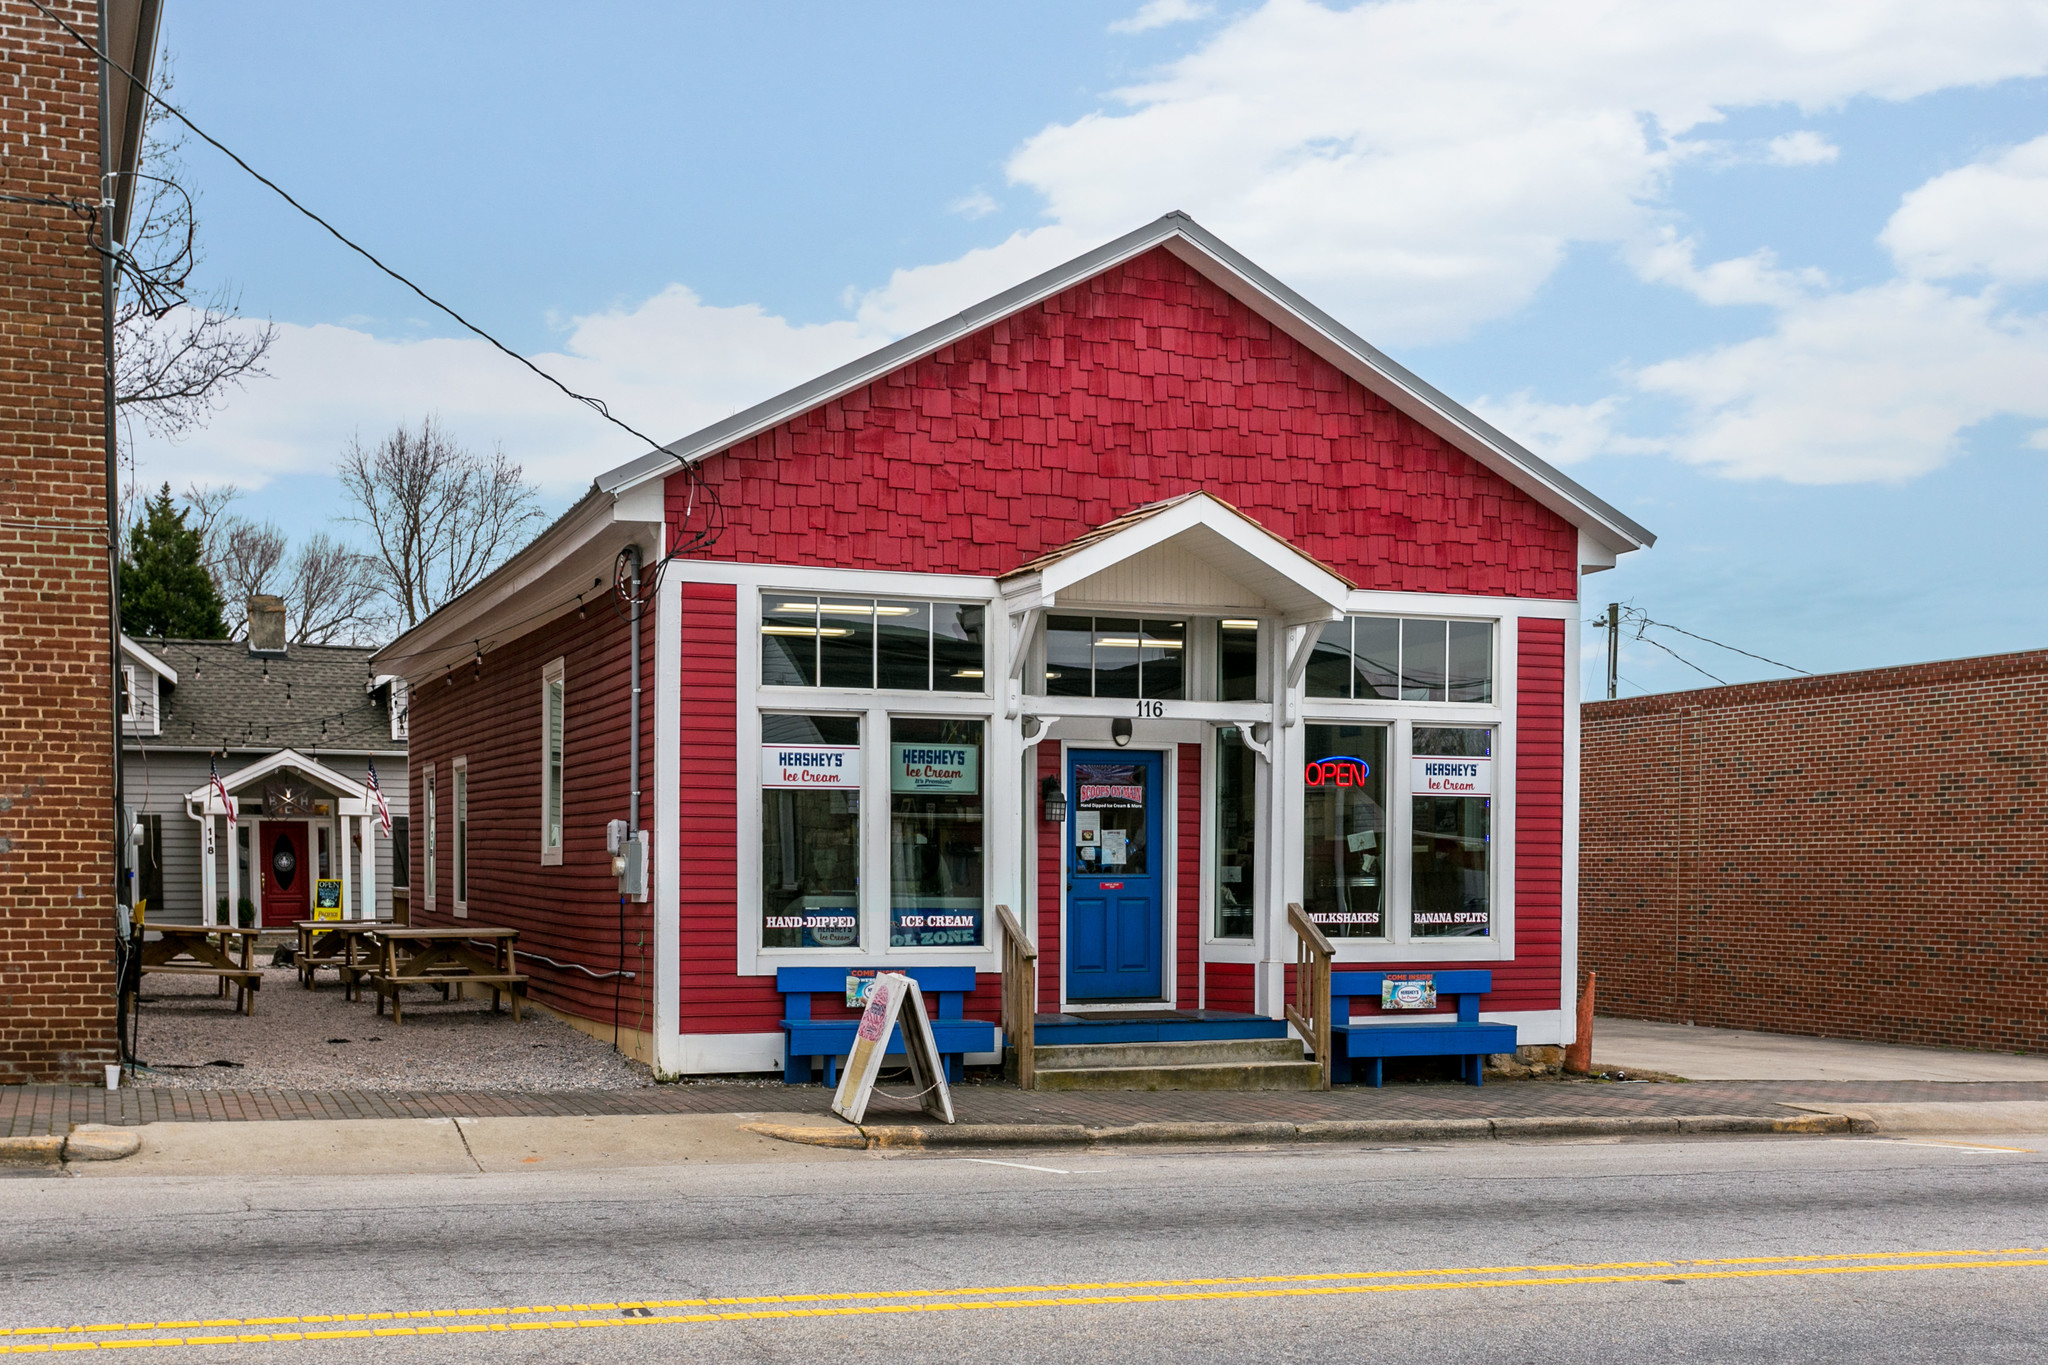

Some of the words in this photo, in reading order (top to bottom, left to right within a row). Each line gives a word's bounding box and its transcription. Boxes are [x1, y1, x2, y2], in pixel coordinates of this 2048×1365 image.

[1136, 700, 1163, 718] 116
[779, 752, 842, 767] HERSHEY'S
[902, 749, 965, 766] HERSHEY'S
[783, 768, 800, 781] Ice
[802, 769, 840, 782] Cream
[906, 764, 922, 777] Ice
[924, 765, 963, 778] Cream
[1305, 762, 1365, 786] OPEN
[1426, 763, 1476, 776] HERSHEY'S
[1428, 778, 1442, 790] Ice
[1443, 779, 1475, 791] Cream
[1080, 785, 1110, 802] SCOOPS
[1110, 785, 1122, 798] ON
[1122, 786, 1142, 803] MAIN
[766, 916, 856, 928] HAND-DIPPED
[901, 916, 924, 926] ICE
[926, 916, 974, 927] CREAM
[1308, 912, 1379, 924] MILKSHAKES
[1414, 913, 1452, 923] BANANA
[1454, 912, 1488, 923] SPLITS
[920, 930, 974, 945] ZONE
